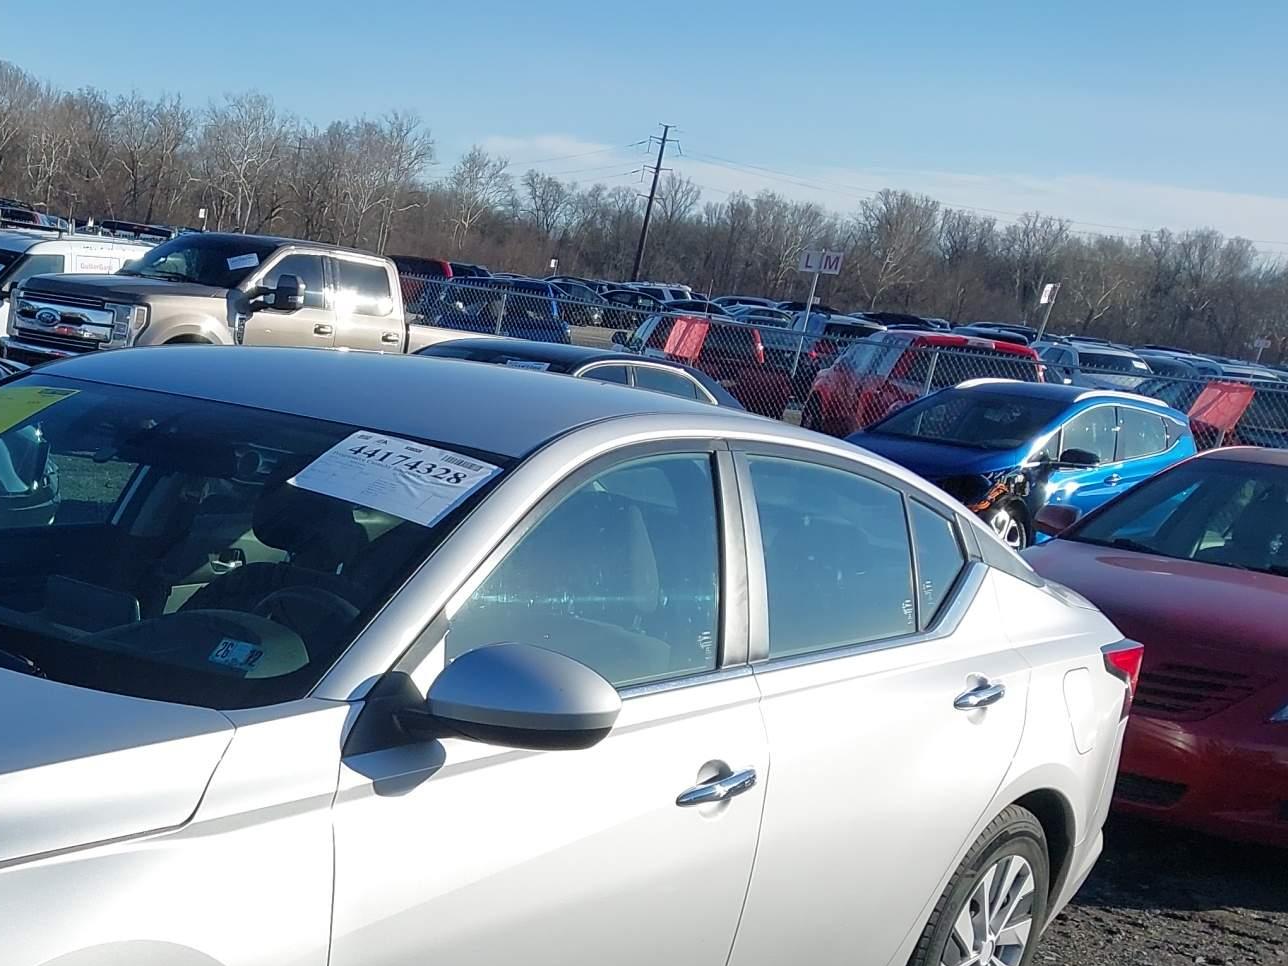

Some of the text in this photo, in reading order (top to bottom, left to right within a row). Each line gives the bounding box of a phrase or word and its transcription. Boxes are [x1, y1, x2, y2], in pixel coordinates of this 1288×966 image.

[805, 253, 813, 269] L
[824, 255, 841, 270] M
[349, 445, 467, 484] 44174328
